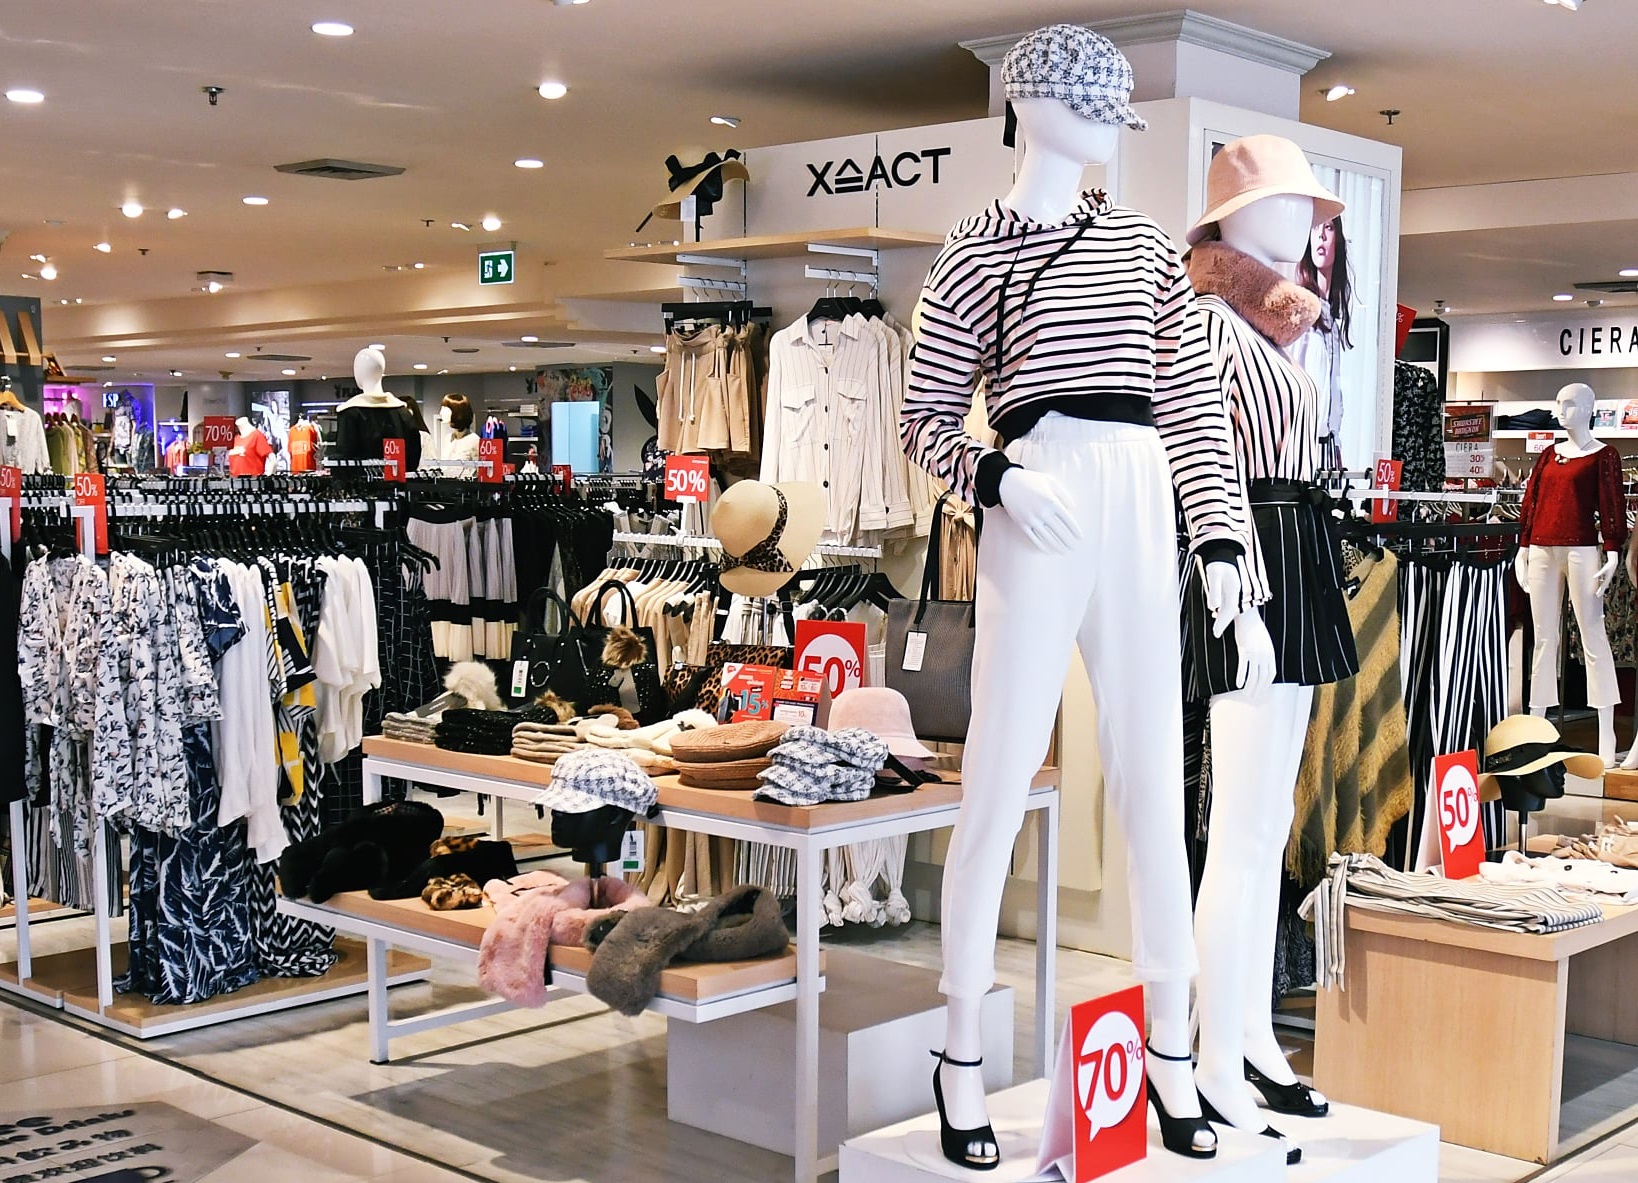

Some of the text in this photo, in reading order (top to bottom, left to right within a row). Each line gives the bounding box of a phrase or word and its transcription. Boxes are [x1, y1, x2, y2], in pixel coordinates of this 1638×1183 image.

[1560, 326, 1638, 356] CIERA
[205, 425, 233, 442] 70%
[385, 440, 400, 455] 60%
[480, 440, 497, 455] 60%
[0, 467, 16, 489] 50%
[667, 469, 706, 493] 50%
[1377, 462, 1395, 483] 50%
[76, 476, 98, 497] 50%
[1443, 786, 1478, 832] 50%
[1079, 1038, 1143, 1112] 70%
